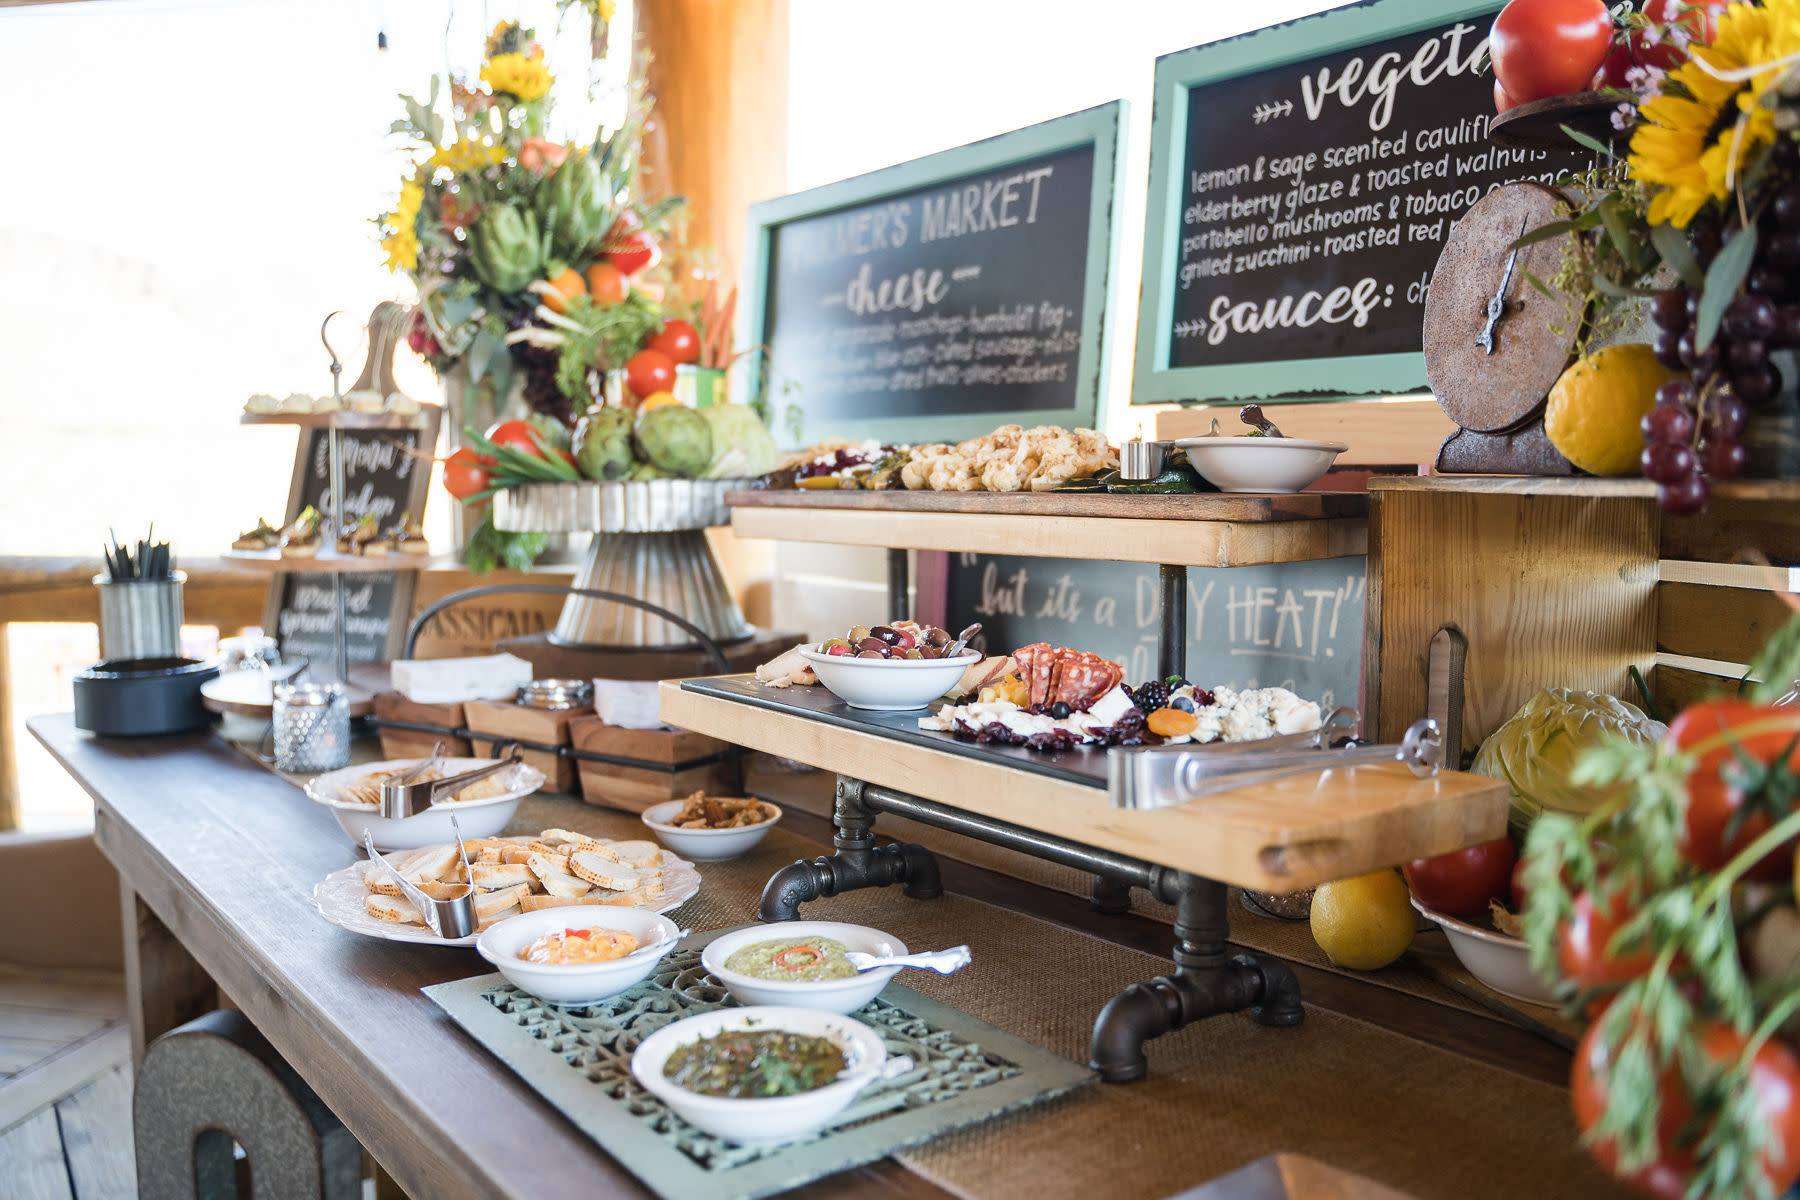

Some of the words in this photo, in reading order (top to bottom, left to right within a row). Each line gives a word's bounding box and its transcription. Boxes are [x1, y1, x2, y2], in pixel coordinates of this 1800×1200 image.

[1184, 191, 1282, 224] elderberry
[1285, 179, 1345, 220] glaze
[1348, 173, 1361, 197] &
[1367, 153, 1450, 191] toasted
[1191, 163, 1250, 194] lemon
[1253, 155, 1266, 182] &
[1269, 151, 1318, 187] sage
[1322, 128, 1408, 169] scented
[1415, 114, 1490, 152] caulifl
[921, 167, 1054, 243] MARKET
[1182, 223, 1269, 261] portobello
[1272, 201, 1385, 240] mushrooms
[1388, 194, 1400, 220] &
[1405, 185, 1480, 217] tobaco
[846, 263, 949, 316] cheese
[1180, 253, 1233, 290] grilled
[1234, 239, 1311, 274] zucchini
[1324, 223, 1400, 257] roasted
[1408, 218, 1443, 242] red
[1207, 277, 1394, 346] sauces:
[1037, 574, 1082, 623] its
[1094, 596, 1116, 627] a
[1135, 575, 1215, 642] DY
